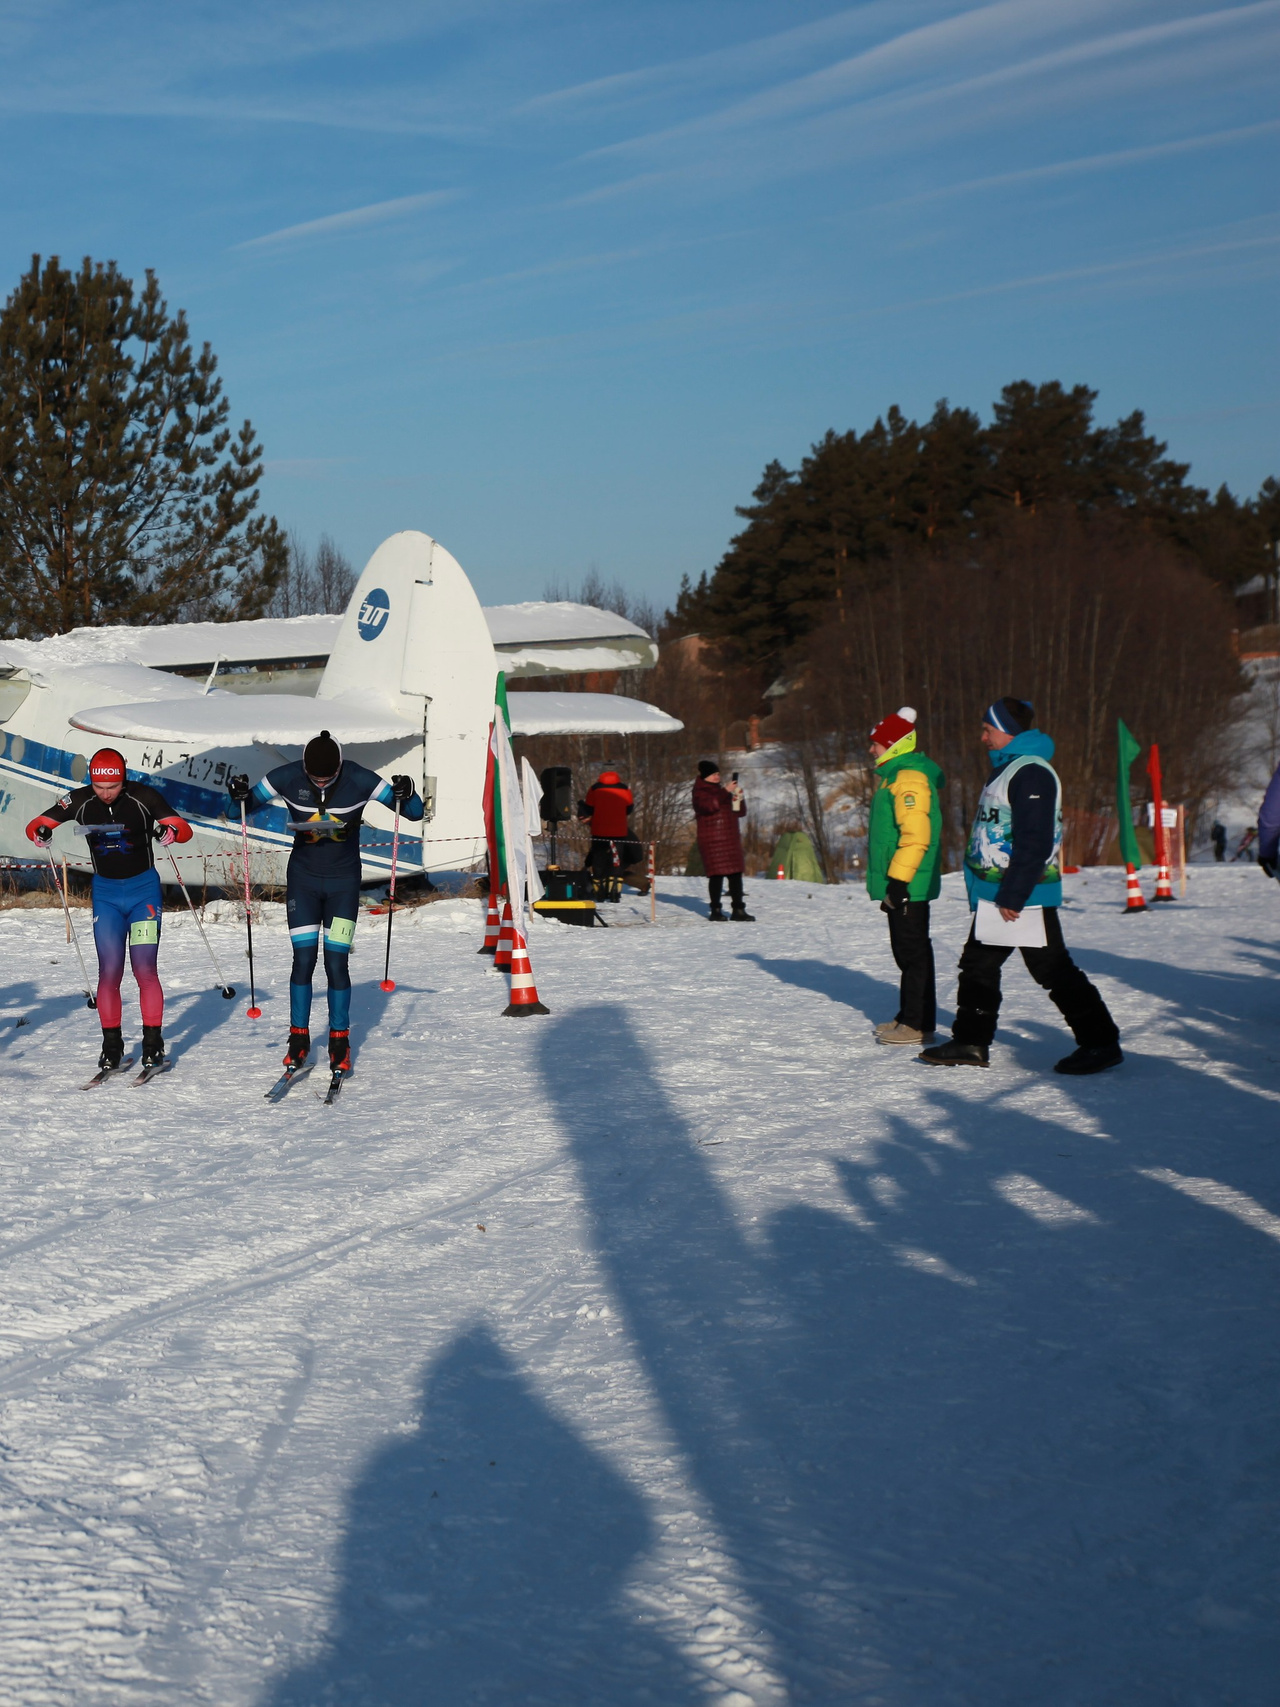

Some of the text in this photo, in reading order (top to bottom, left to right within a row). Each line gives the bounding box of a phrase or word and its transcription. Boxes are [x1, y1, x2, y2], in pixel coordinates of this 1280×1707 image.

[92, 767, 121, 776] LUKOIL
[137, 928, 149, 937] 2.1
[341, 927, 352, 937] 1.1
